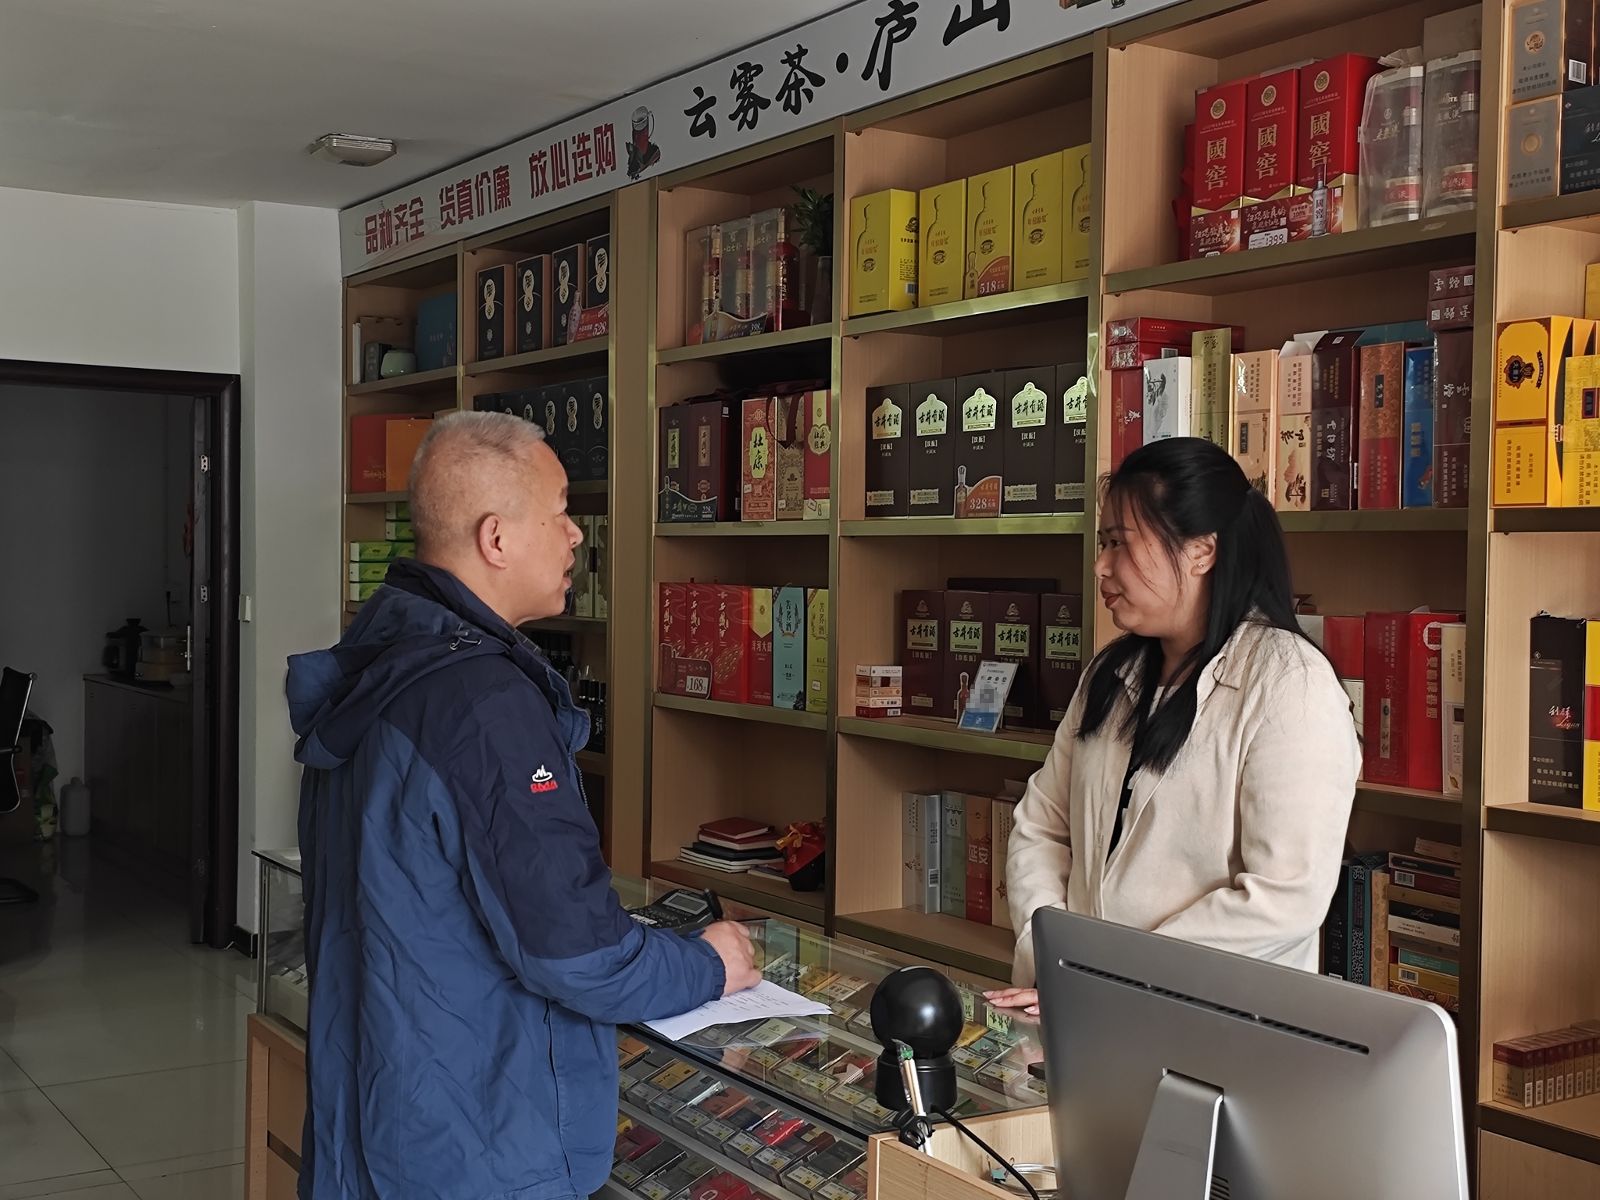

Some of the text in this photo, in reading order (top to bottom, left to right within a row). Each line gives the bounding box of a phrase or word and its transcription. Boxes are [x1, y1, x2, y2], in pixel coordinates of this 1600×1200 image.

[529, 122, 616, 199] 放心选购
[1205, 137, 1227, 191] 國窖
[1256, 124, 1278, 180] 國窖
[439, 165, 511, 230] 货真价廉
[365, 196, 424, 254] 品种齐全
[979, 280, 997, 295] 518
[1124, 409, 1142, 425] 泰山
[753, 433, 764, 470] 杜康
[1326, 419, 1337, 461] 好日子
[969, 498, 987, 510] 328
[689, 678, 703, 693] 168
